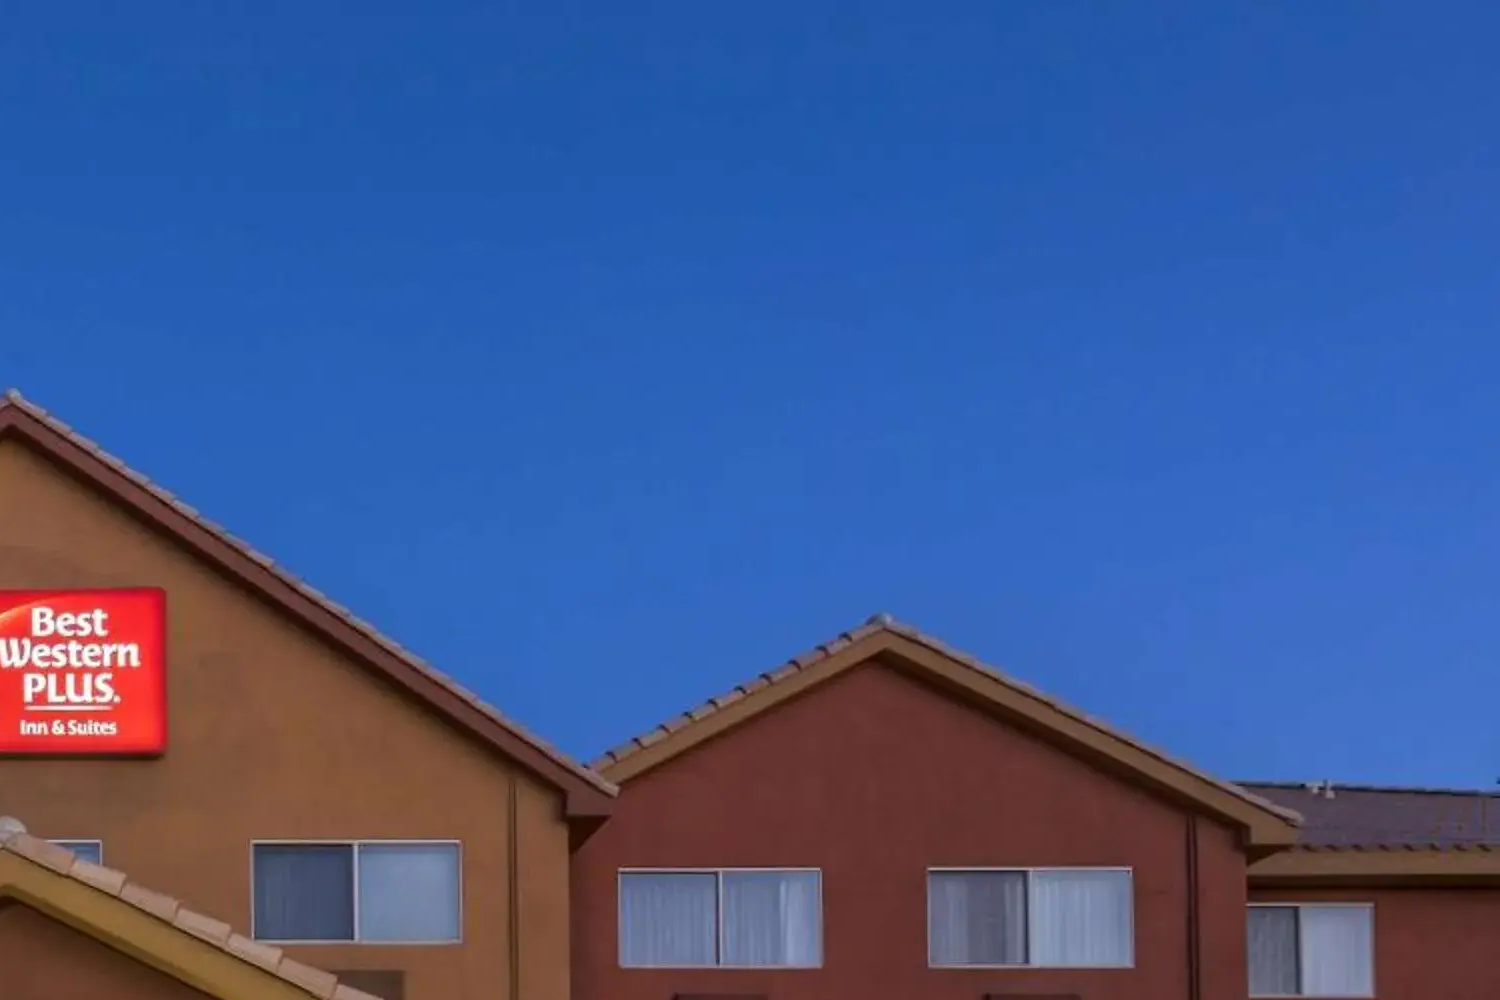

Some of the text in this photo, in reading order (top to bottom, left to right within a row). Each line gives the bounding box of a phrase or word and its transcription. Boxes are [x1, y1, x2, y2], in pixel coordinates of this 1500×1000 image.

[31, 607, 109, 637] Best
[19, 719, 118, 736] Inn & Suites
